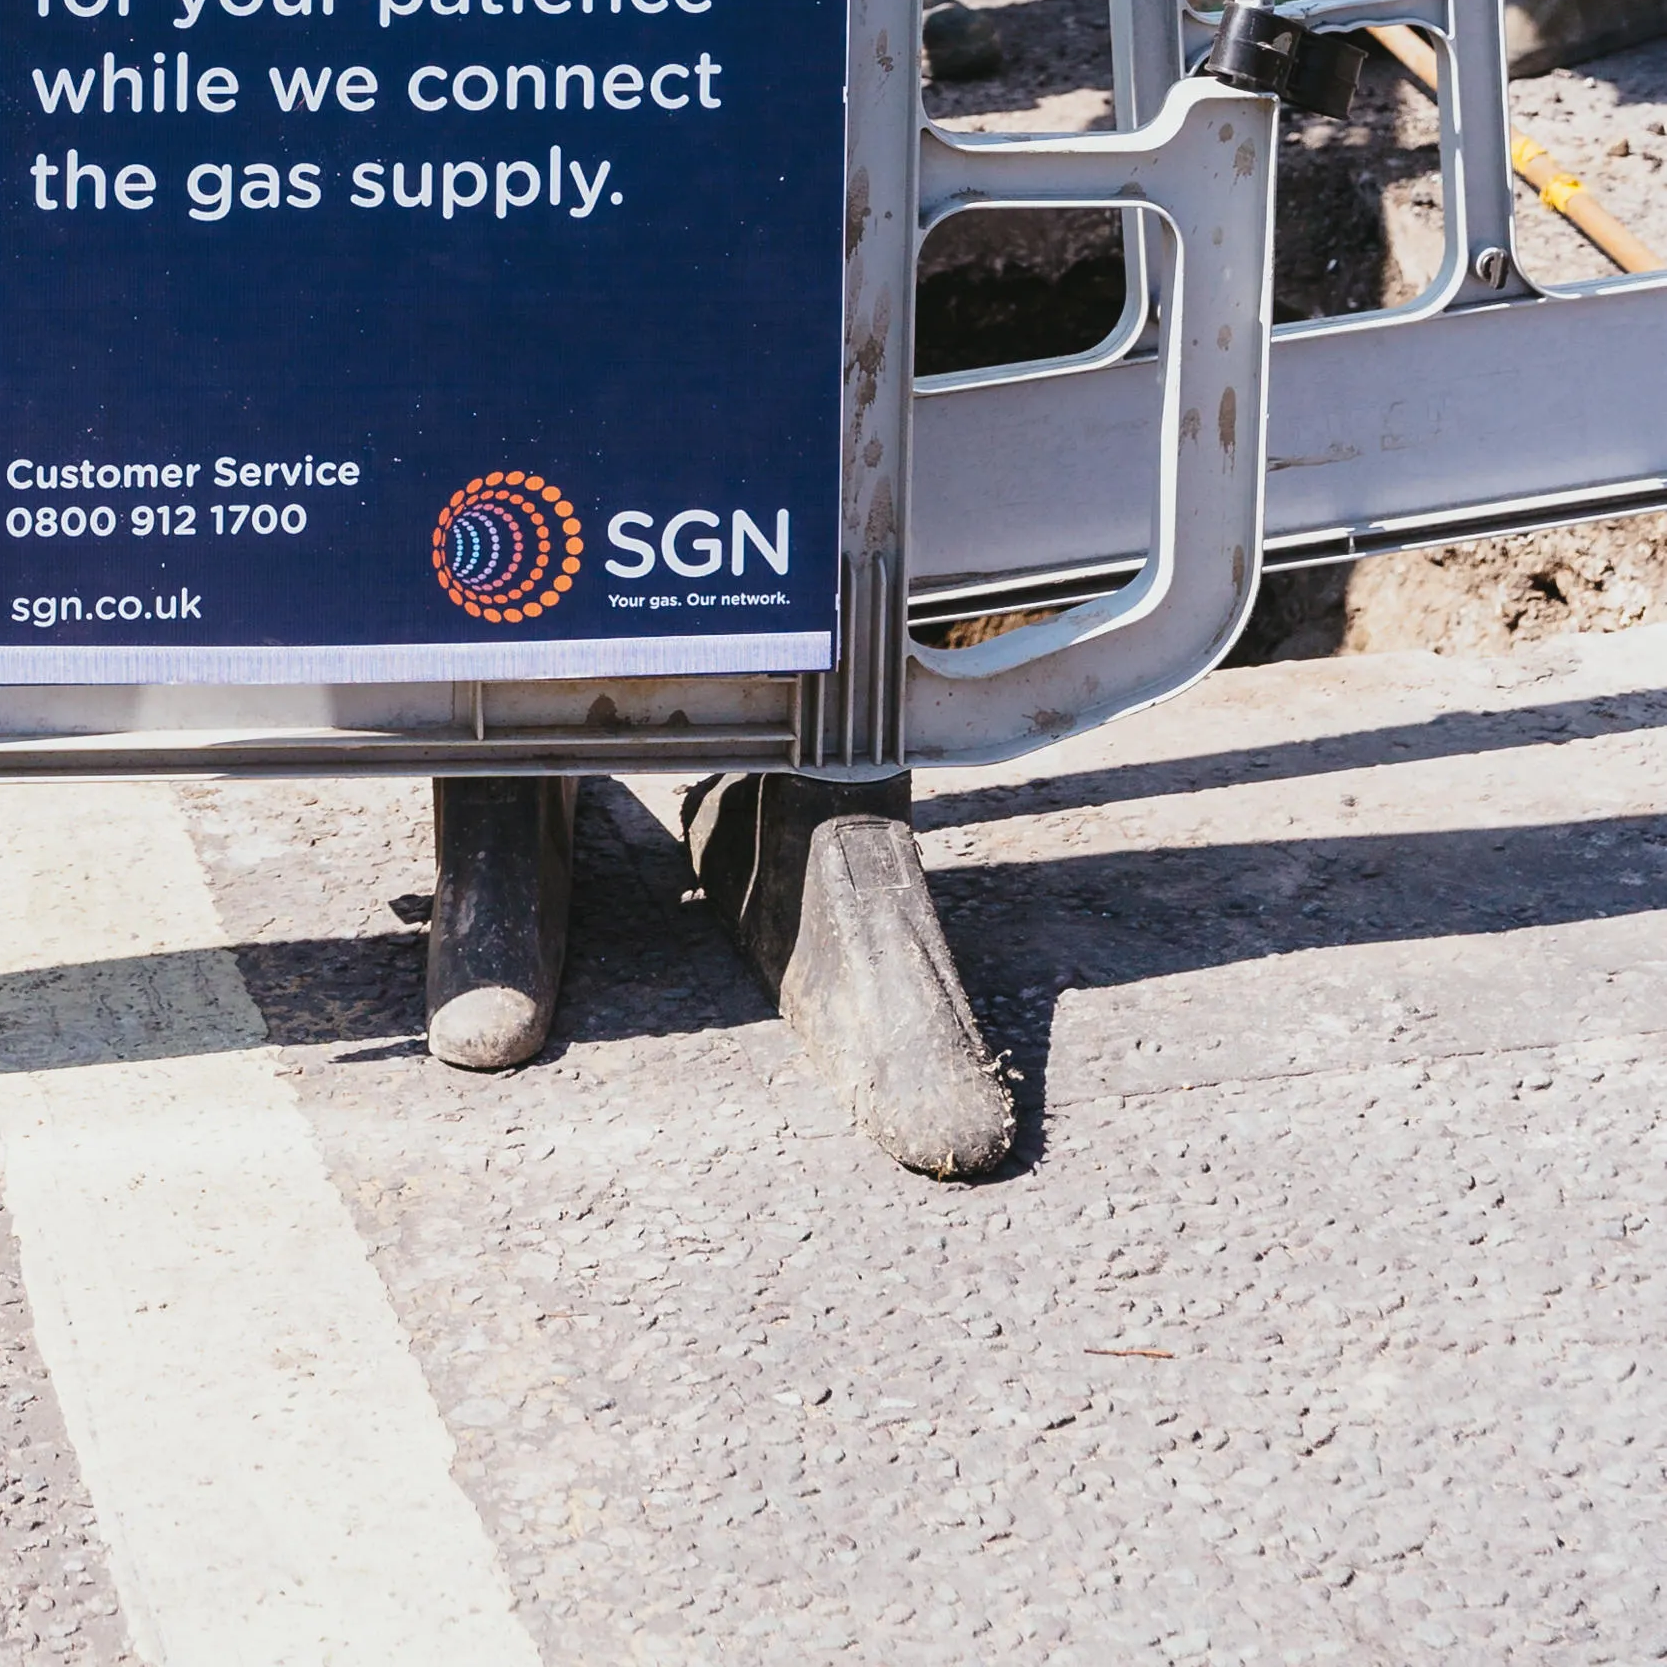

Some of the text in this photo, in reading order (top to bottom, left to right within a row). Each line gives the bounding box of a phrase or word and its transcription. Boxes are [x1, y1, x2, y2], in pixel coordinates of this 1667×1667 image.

[31, 51, 722, 114] while we connect
[29, 144, 623, 222] the gas supply.
[6, 454, 360, 490] Customer Service
[5, 503, 307, 538] 0800 912 1700
[604, 508, 789, 579] SGN
[11, 587, 202, 628] sgn.co.uk
[608, 591, 791, 610] Your gas. Our network.
